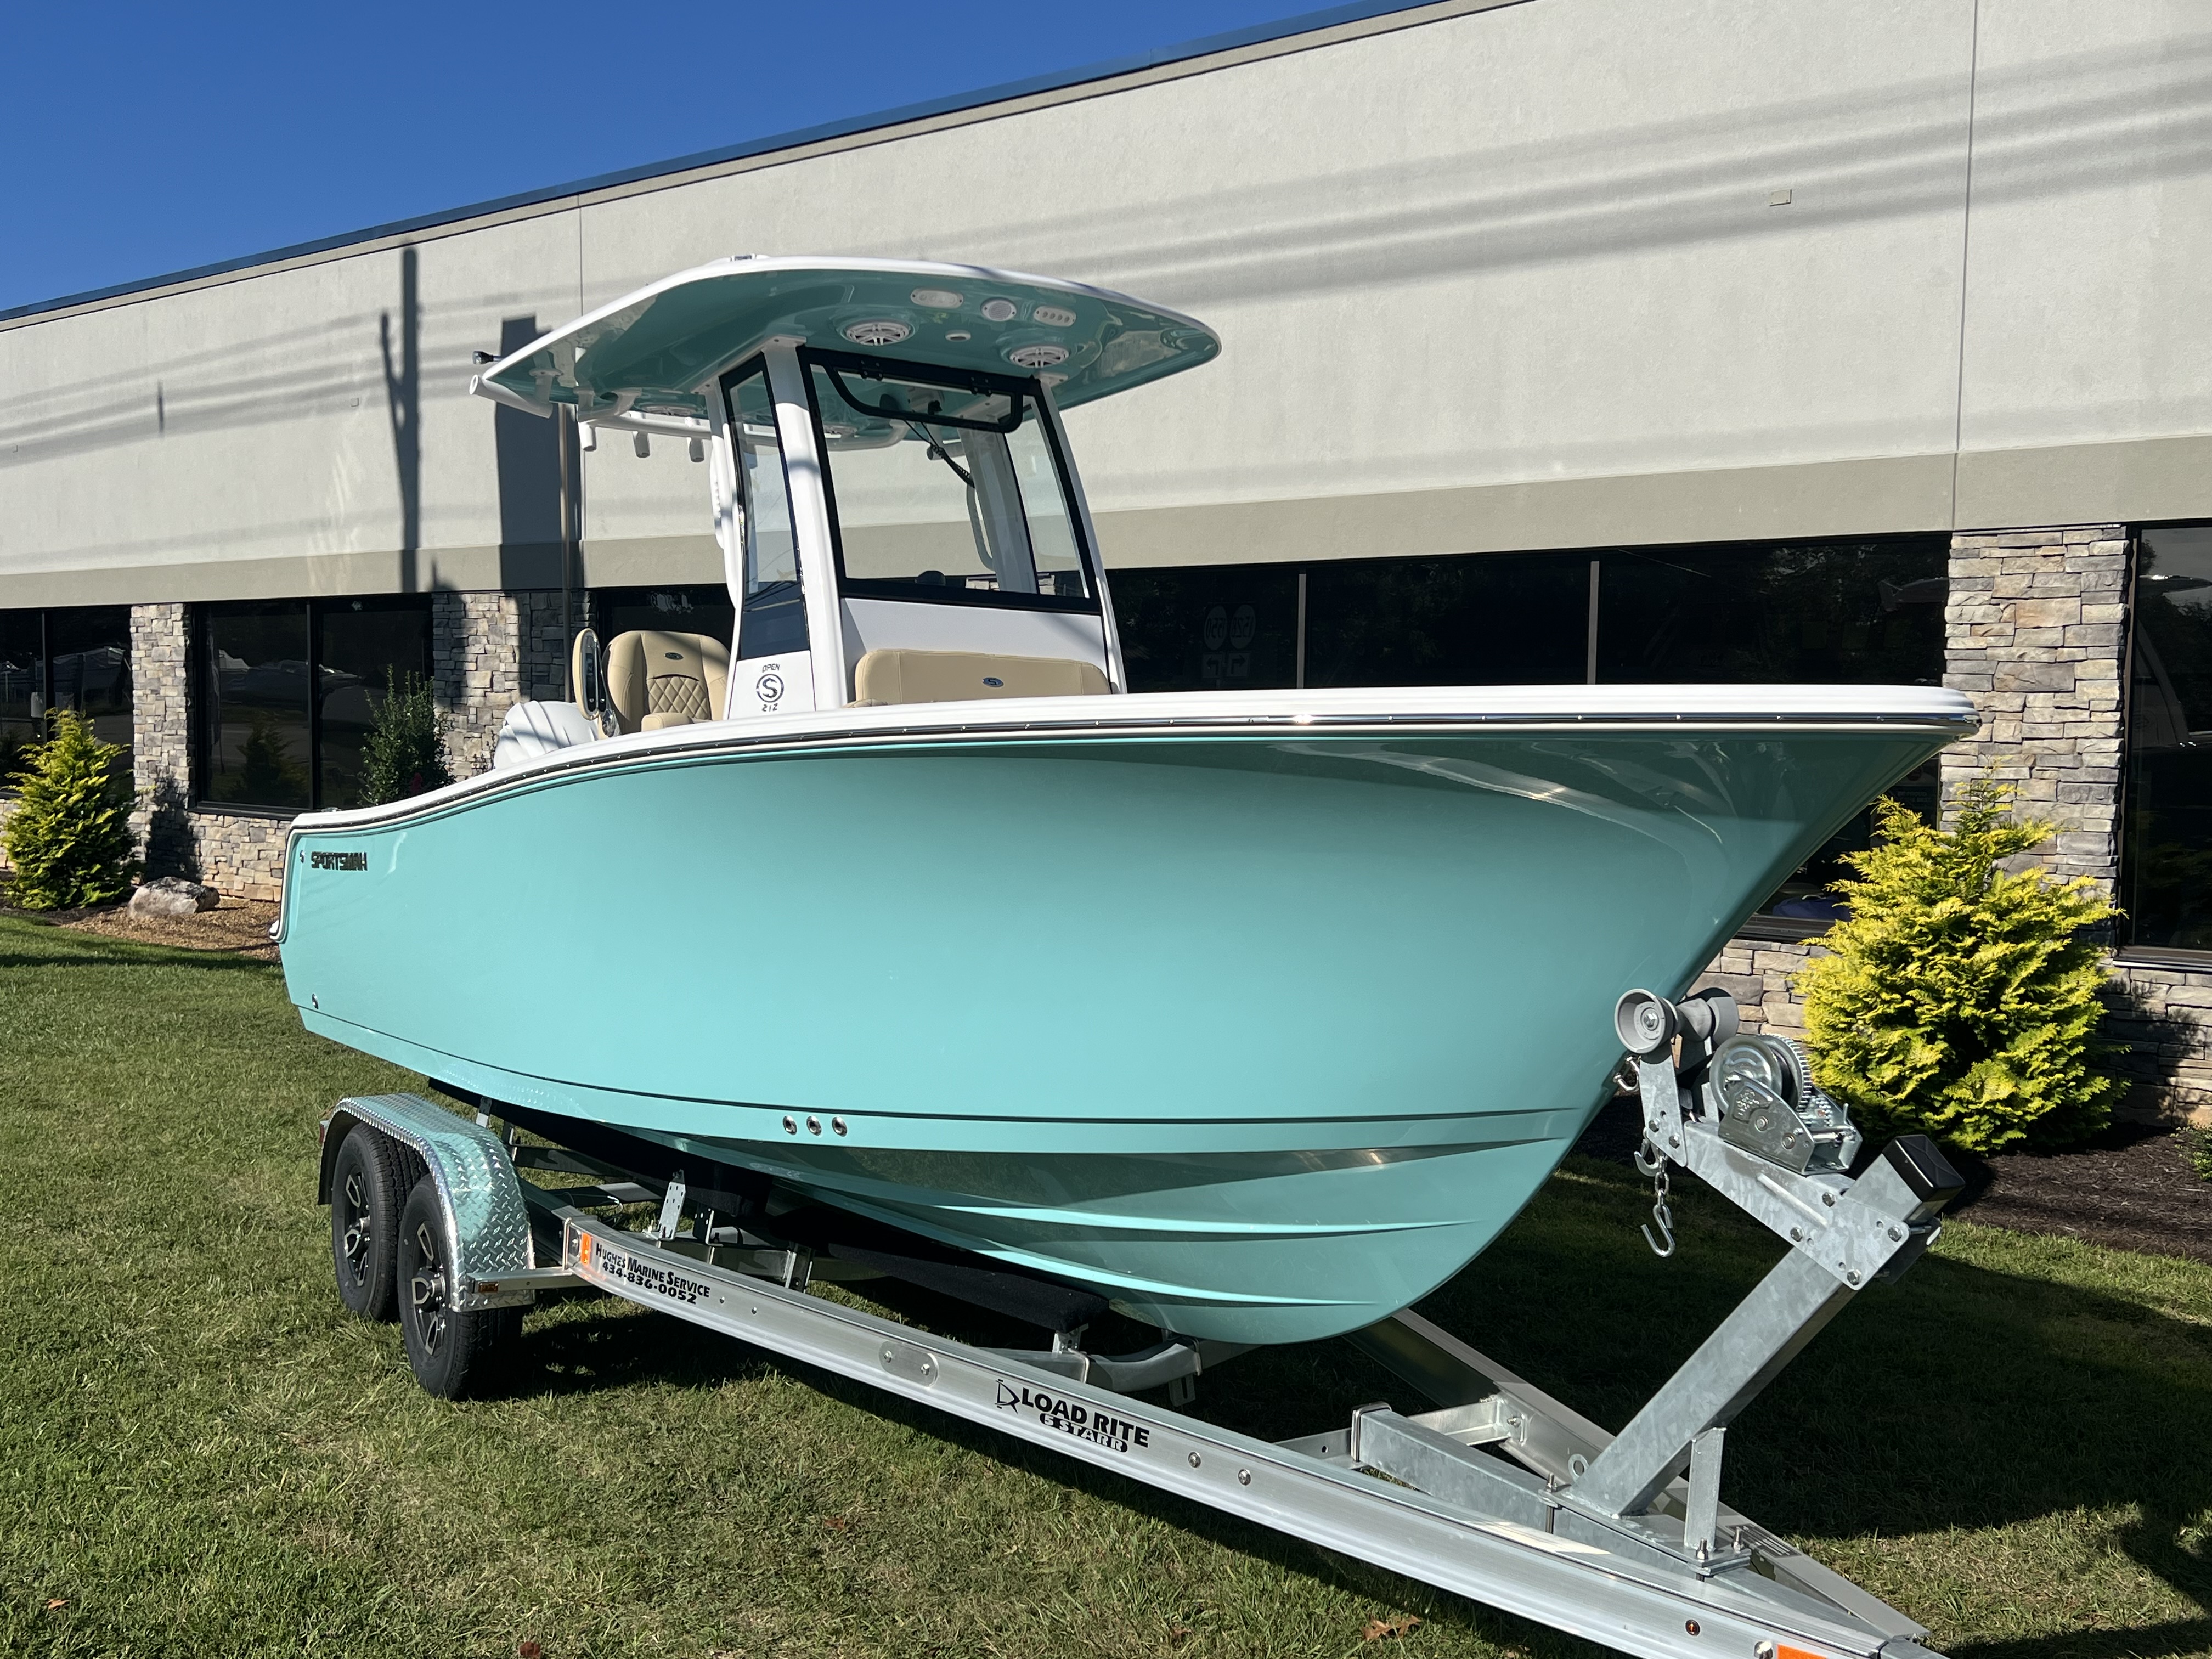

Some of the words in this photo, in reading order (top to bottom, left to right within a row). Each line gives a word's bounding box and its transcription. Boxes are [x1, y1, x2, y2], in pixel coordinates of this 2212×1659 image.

[762, 663, 780, 673] OPEN
[761, 703, 778, 712] 212
[311, 851, 368, 871] SPORTSMAN
[596, 1242, 626, 1269] HUGHES
[627, 1257, 665, 1283] MARINE
[667, 1271, 710, 1298] SERVICE
[602, 1261, 697, 1305] 434-836-0052
[1022, 1387, 1087, 1425] LOAD
[1093, 1412, 1150, 1448] RITE
[1044, 1414, 1054, 1426] 5
[1059, 1420, 1124, 1452] STARR
